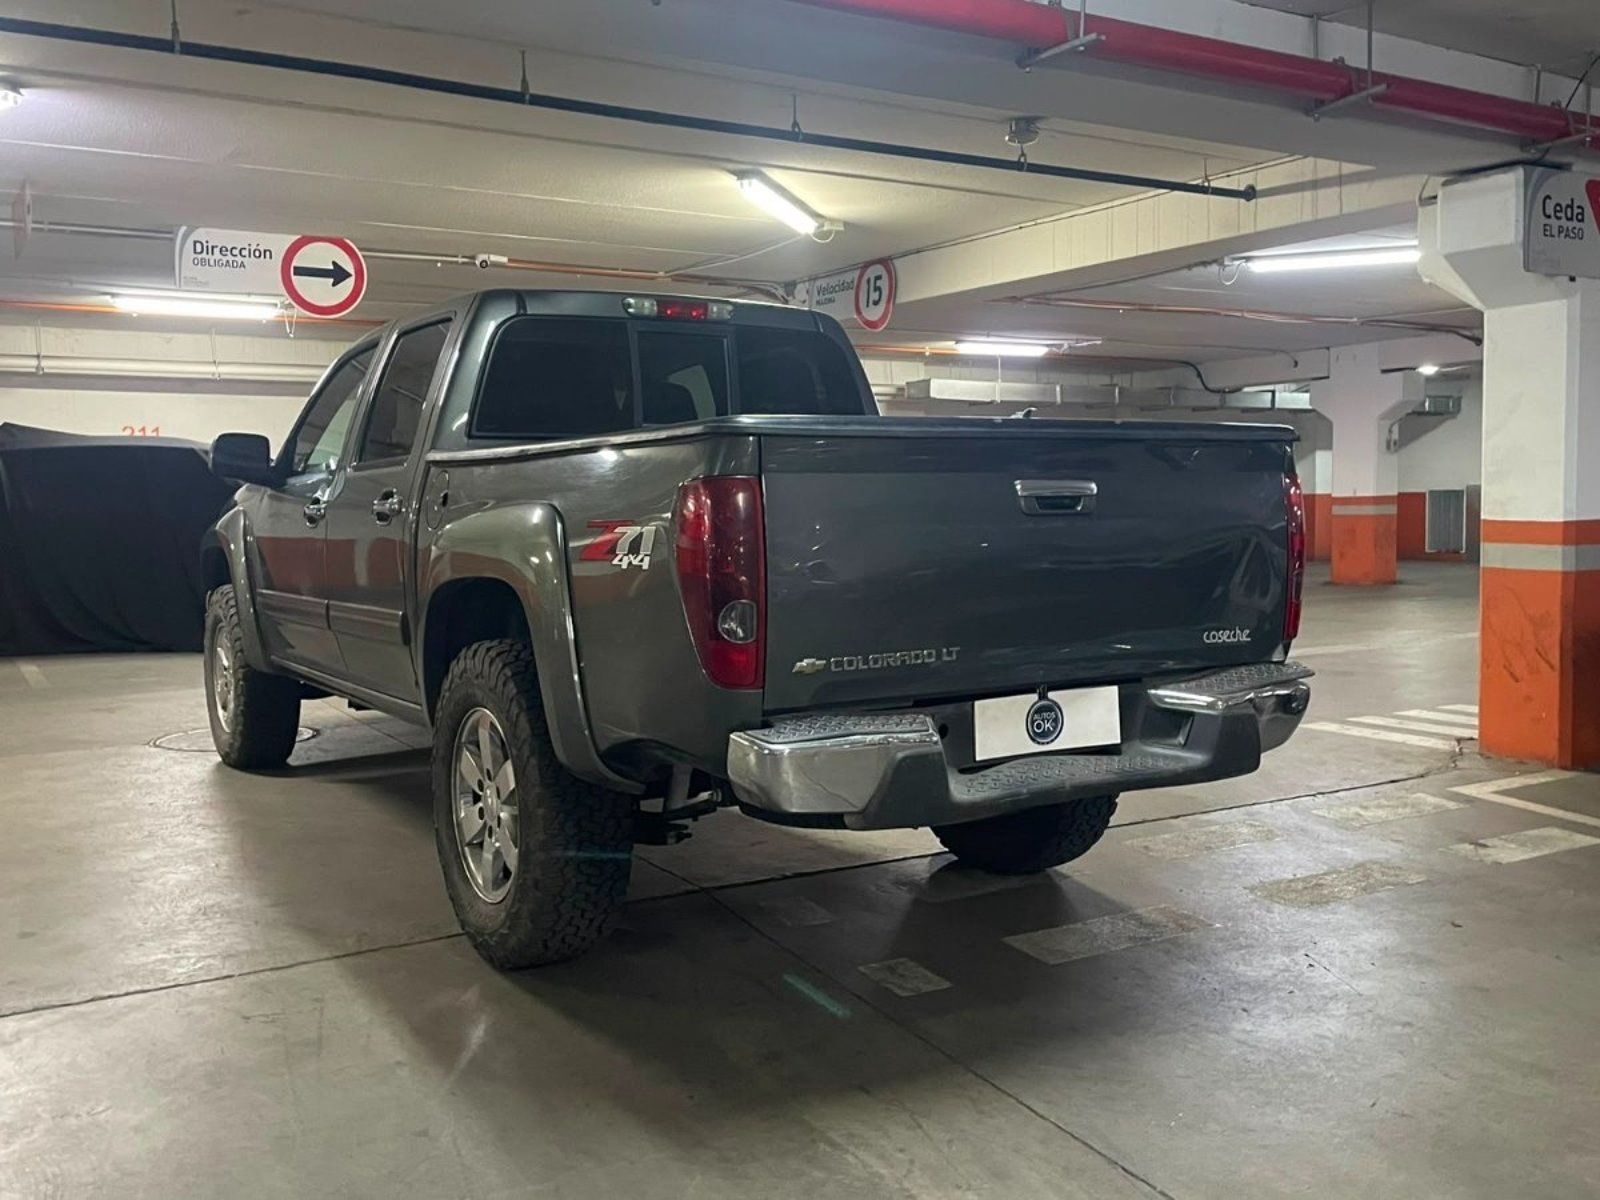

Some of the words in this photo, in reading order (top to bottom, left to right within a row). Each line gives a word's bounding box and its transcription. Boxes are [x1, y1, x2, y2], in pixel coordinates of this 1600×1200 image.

[1542, 194, 1585, 223] Ceda
[1543, 223, 1555, 238] EL
[1558, 225, 1584, 240] PASO
[192, 239, 273, 260] Dirección
[192, 257, 246, 269] OBLIGADA
[816, 277, 855, 296] Velocidad
[866, 274, 883, 308] 15
[580, 519, 657, 561] Z71
[1203, 626, 1251, 643] coseche
[830, 649, 936, 672] COLORADO
[942, 646, 961, 661] LT
[1033, 711, 1056, 721] AUTOS
[1033, 719, 1054, 733] OK
